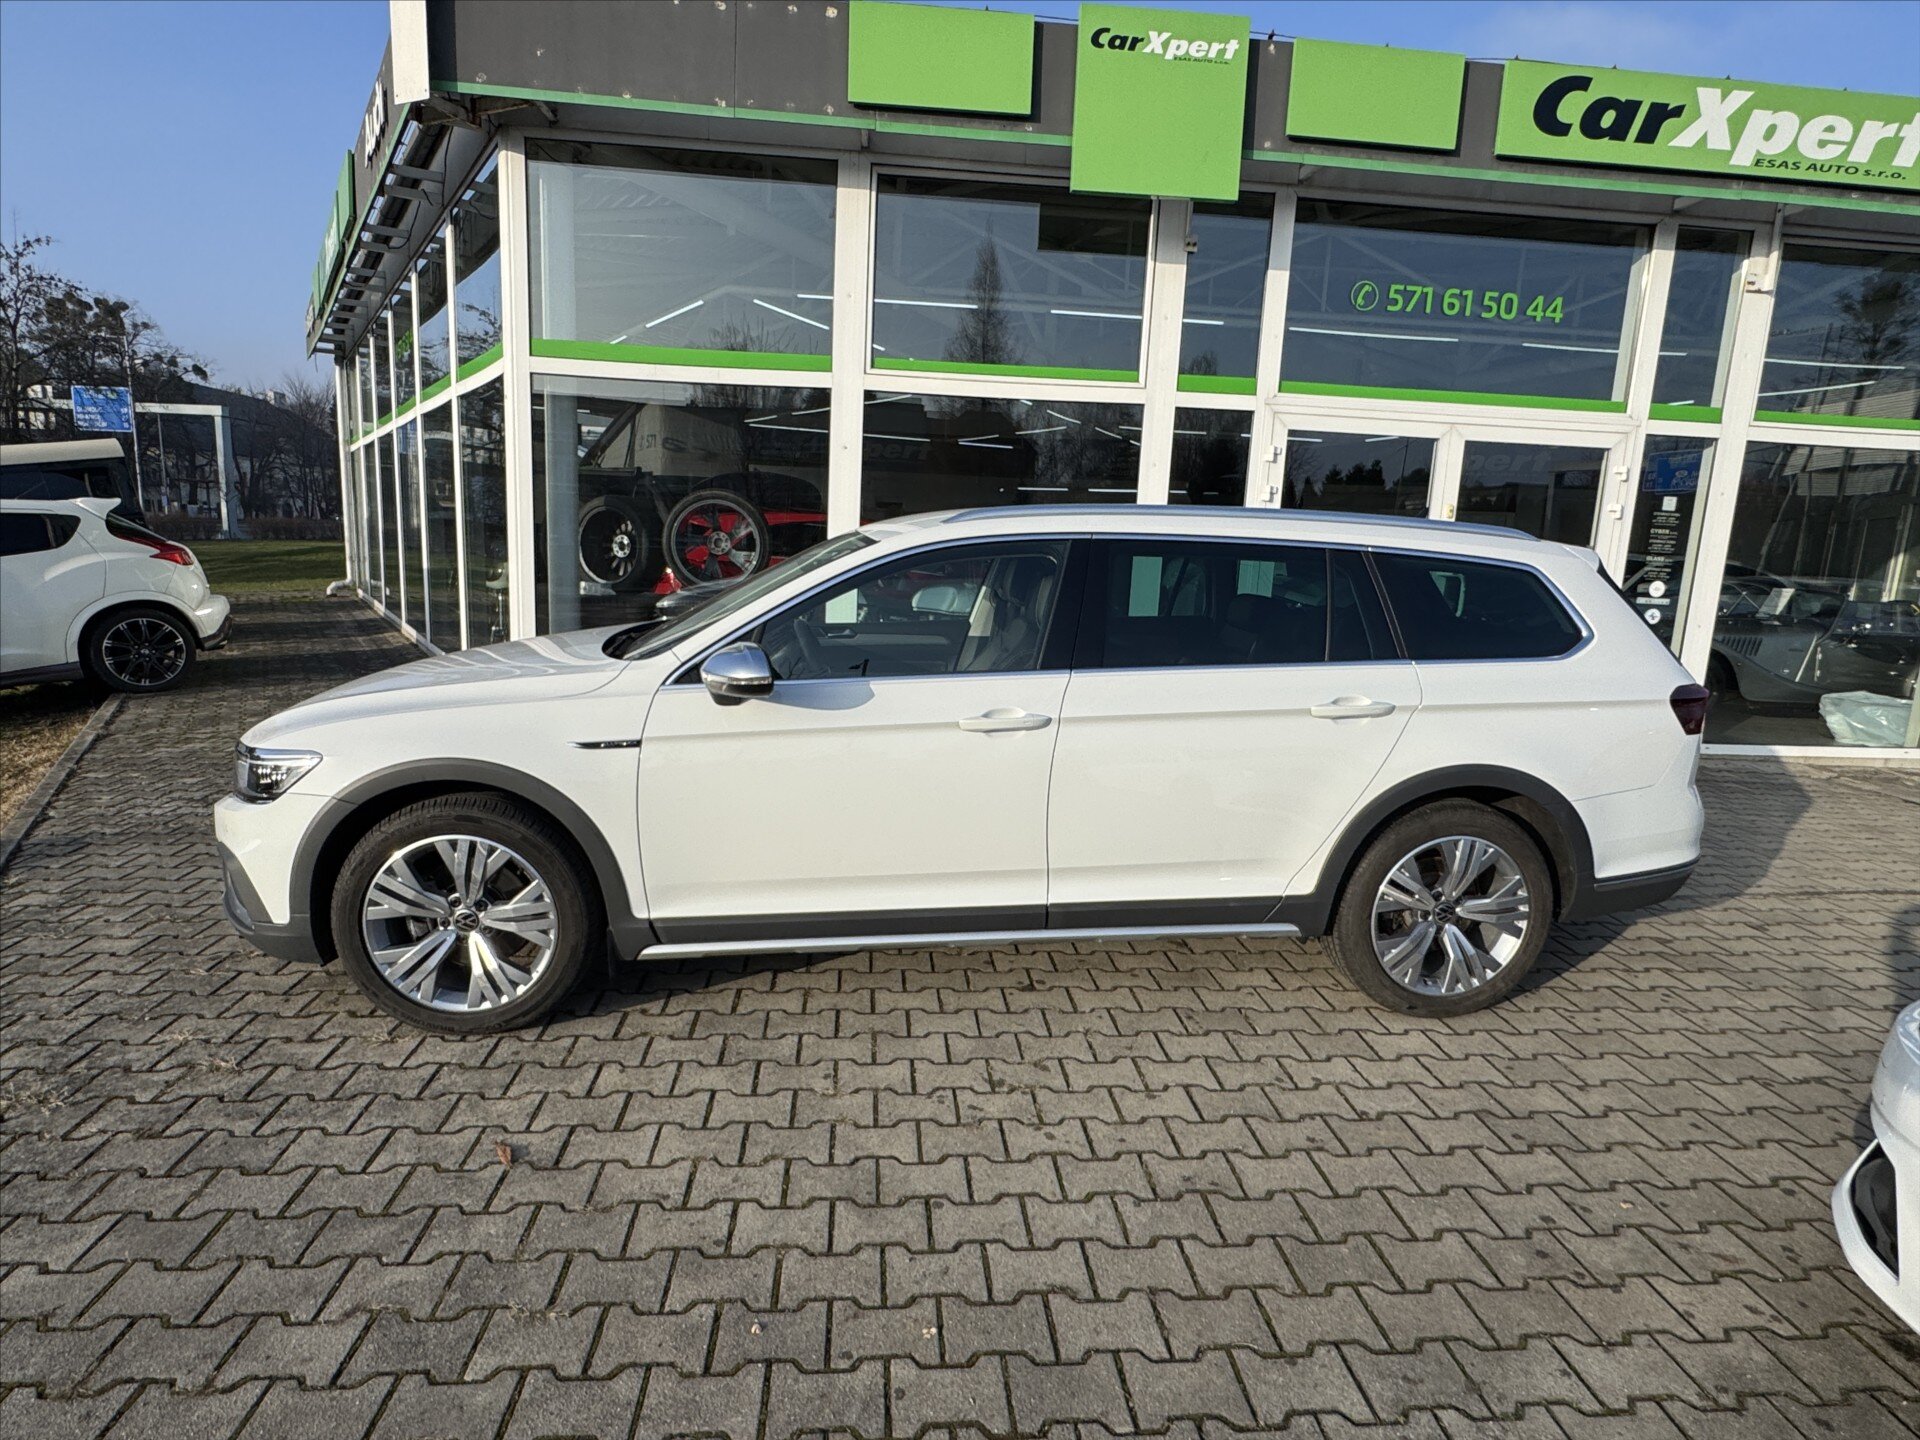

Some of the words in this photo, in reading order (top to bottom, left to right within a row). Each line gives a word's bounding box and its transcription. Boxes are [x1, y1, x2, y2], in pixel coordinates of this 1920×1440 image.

[1091, 27, 1240, 60] CarXpert
[1754, 158, 1801, 171] ESAS
[1805, 162, 1859, 175] AUTO
[1862, 169, 1907, 180] s.r.o.
[1386, 284, 1434, 314] 571
[1442, 288, 1474, 317] 61
[1481, 291, 1519, 320] 50
[1526, 295, 1564, 323] 44
